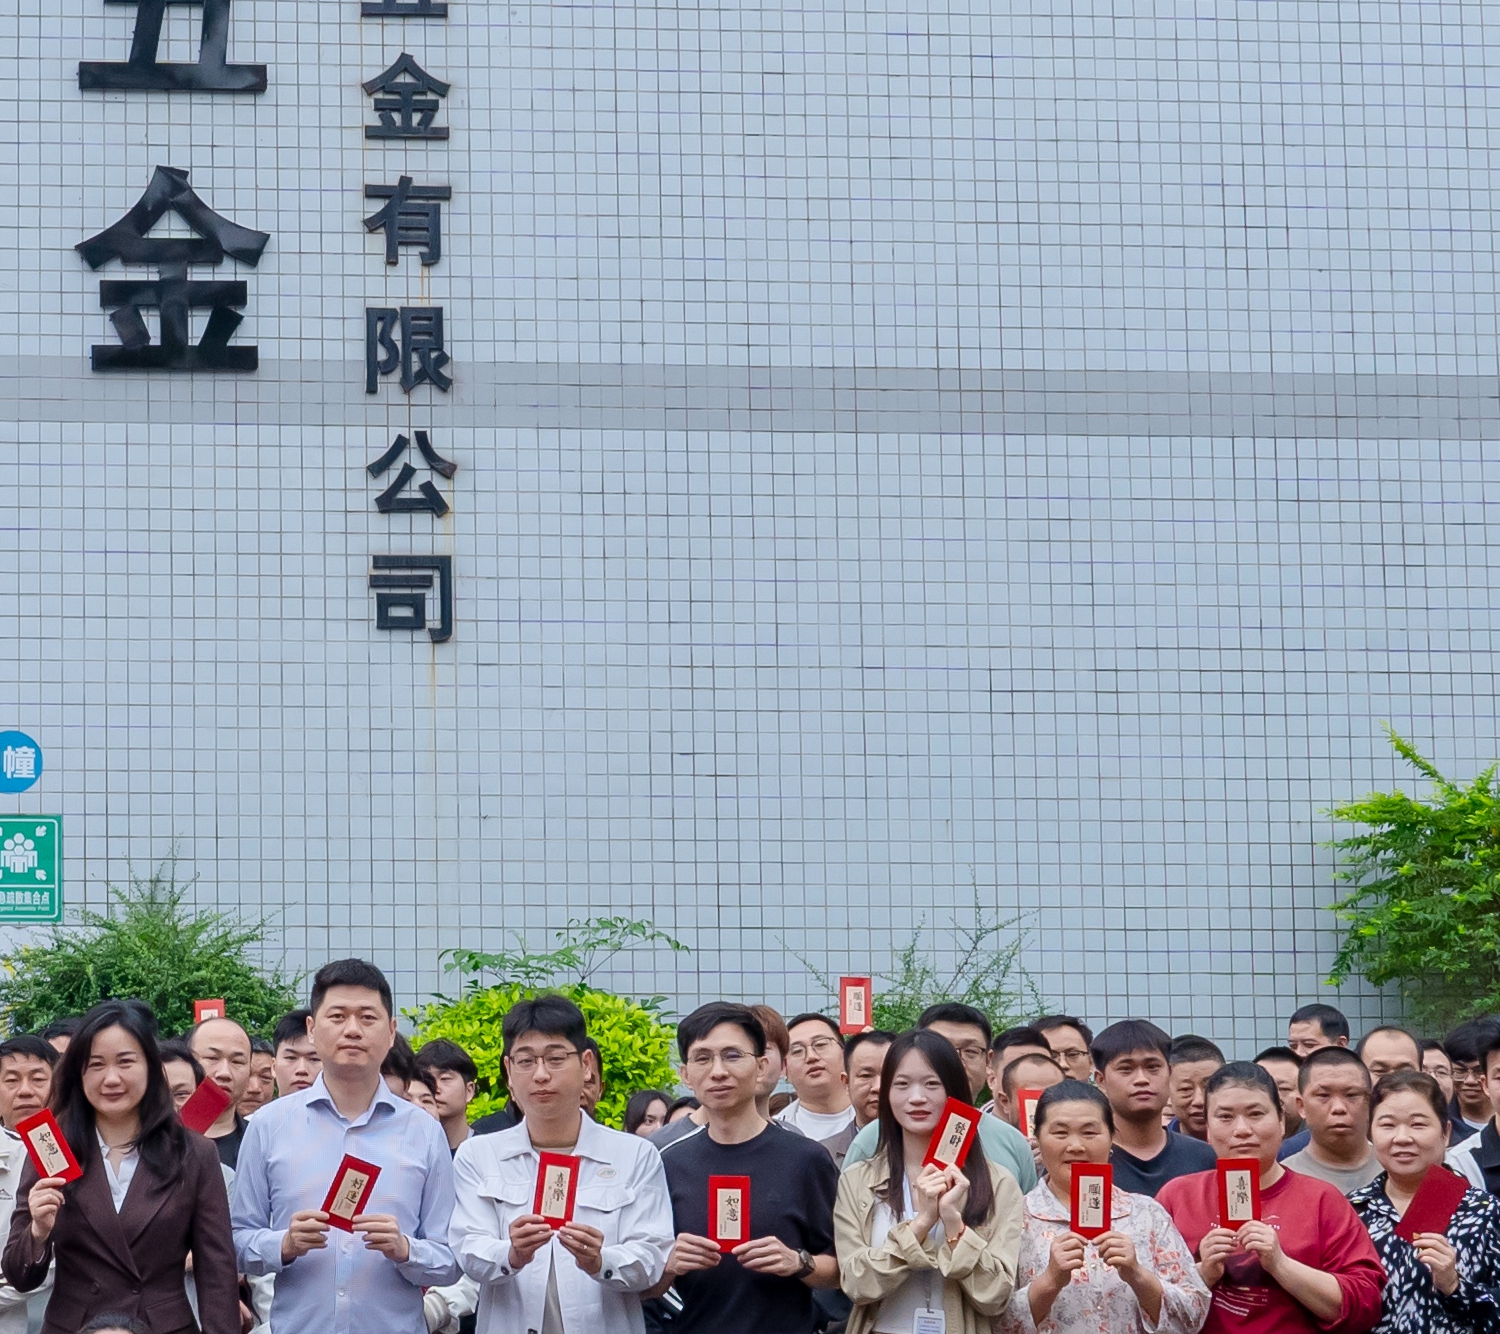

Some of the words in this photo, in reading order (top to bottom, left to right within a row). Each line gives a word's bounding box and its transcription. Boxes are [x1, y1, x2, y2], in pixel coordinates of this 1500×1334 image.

[38, 1130, 57, 1157] 如意
[948, 1120, 966, 1147] 發財
[348, 1176, 364, 1203] 好運
[724, 1195, 740, 1223] 如意
